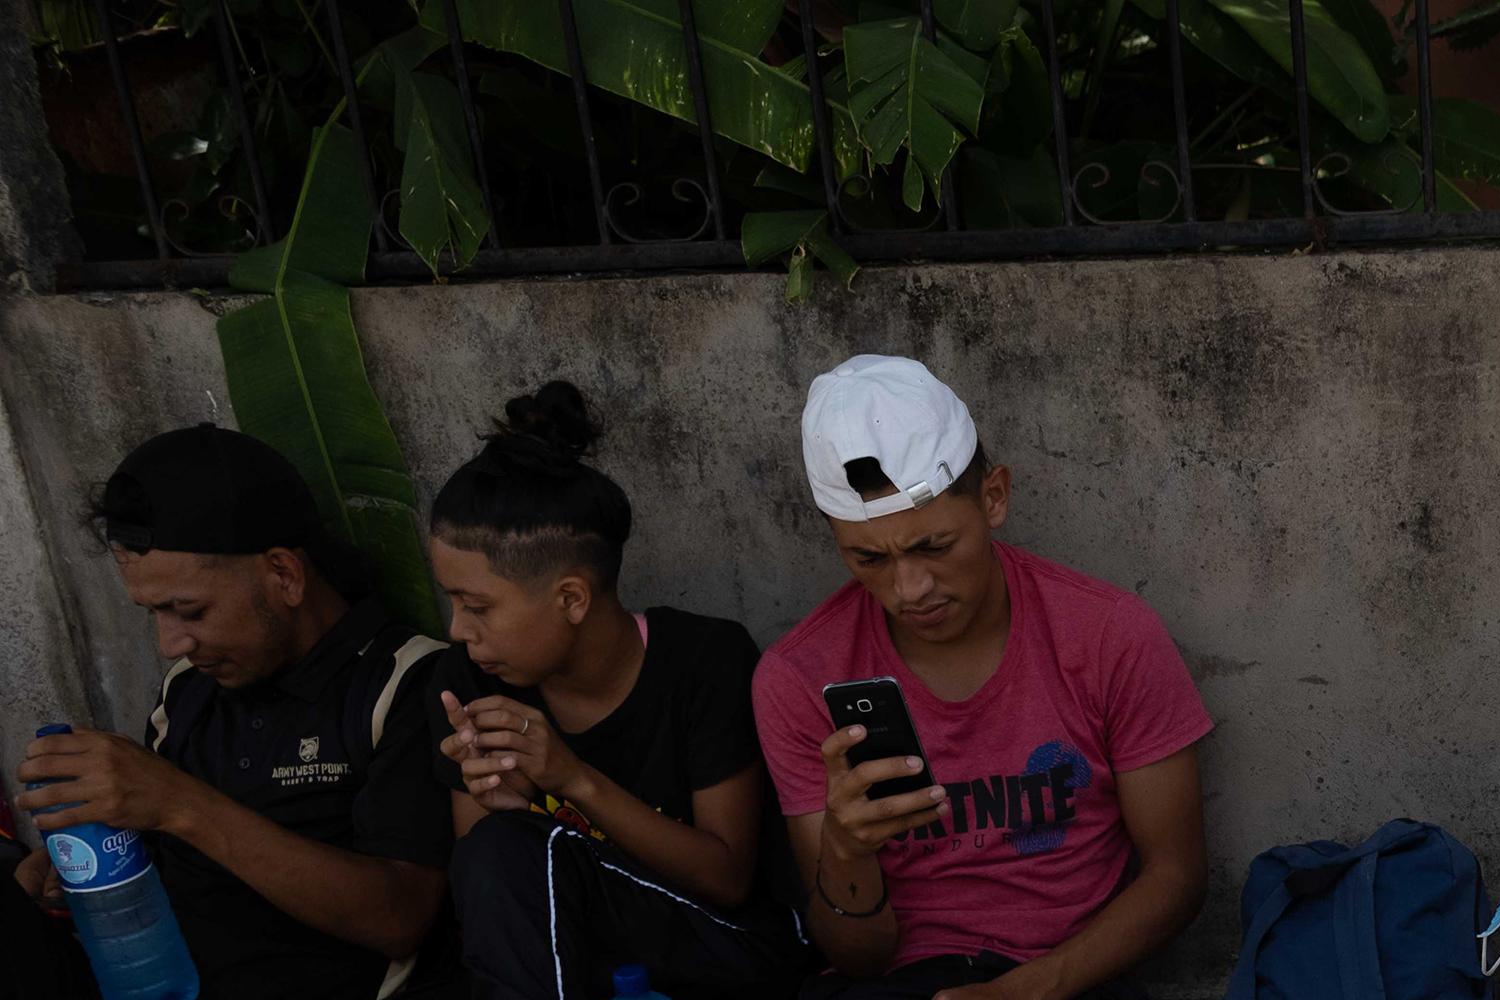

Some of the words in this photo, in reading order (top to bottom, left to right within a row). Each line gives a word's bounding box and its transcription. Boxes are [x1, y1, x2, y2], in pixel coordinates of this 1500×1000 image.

[272, 765, 294, 778] ARMY
[296, 763, 320, 776] WEST
[321, 763, 349, 775] POINT
